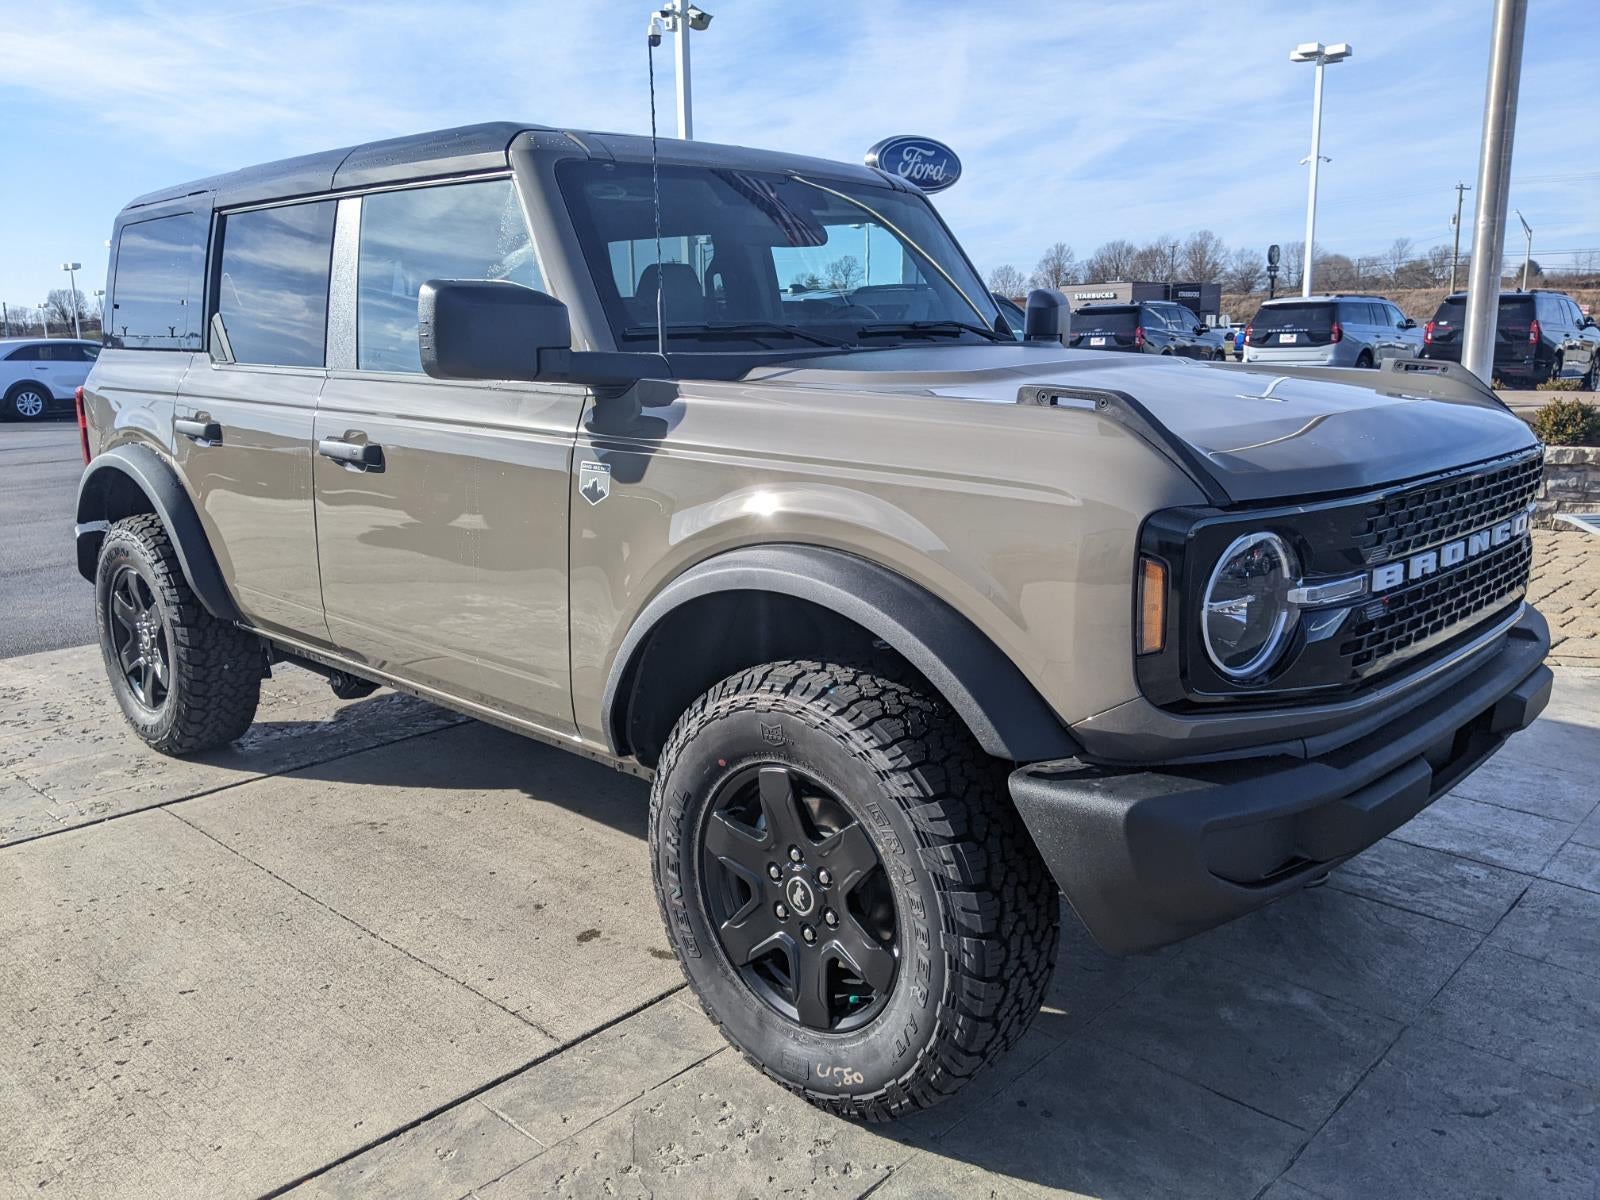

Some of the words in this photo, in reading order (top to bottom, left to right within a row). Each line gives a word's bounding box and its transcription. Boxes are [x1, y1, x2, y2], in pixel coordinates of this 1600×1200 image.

[897, 146, 947, 181] Ford
[1074, 292, 1115, 300] STARBUCKS
[1371, 511, 1529, 592] BRONCO
[665, 790, 702, 959] GENERAL
[866, 800, 932, 1010] GRABBER
